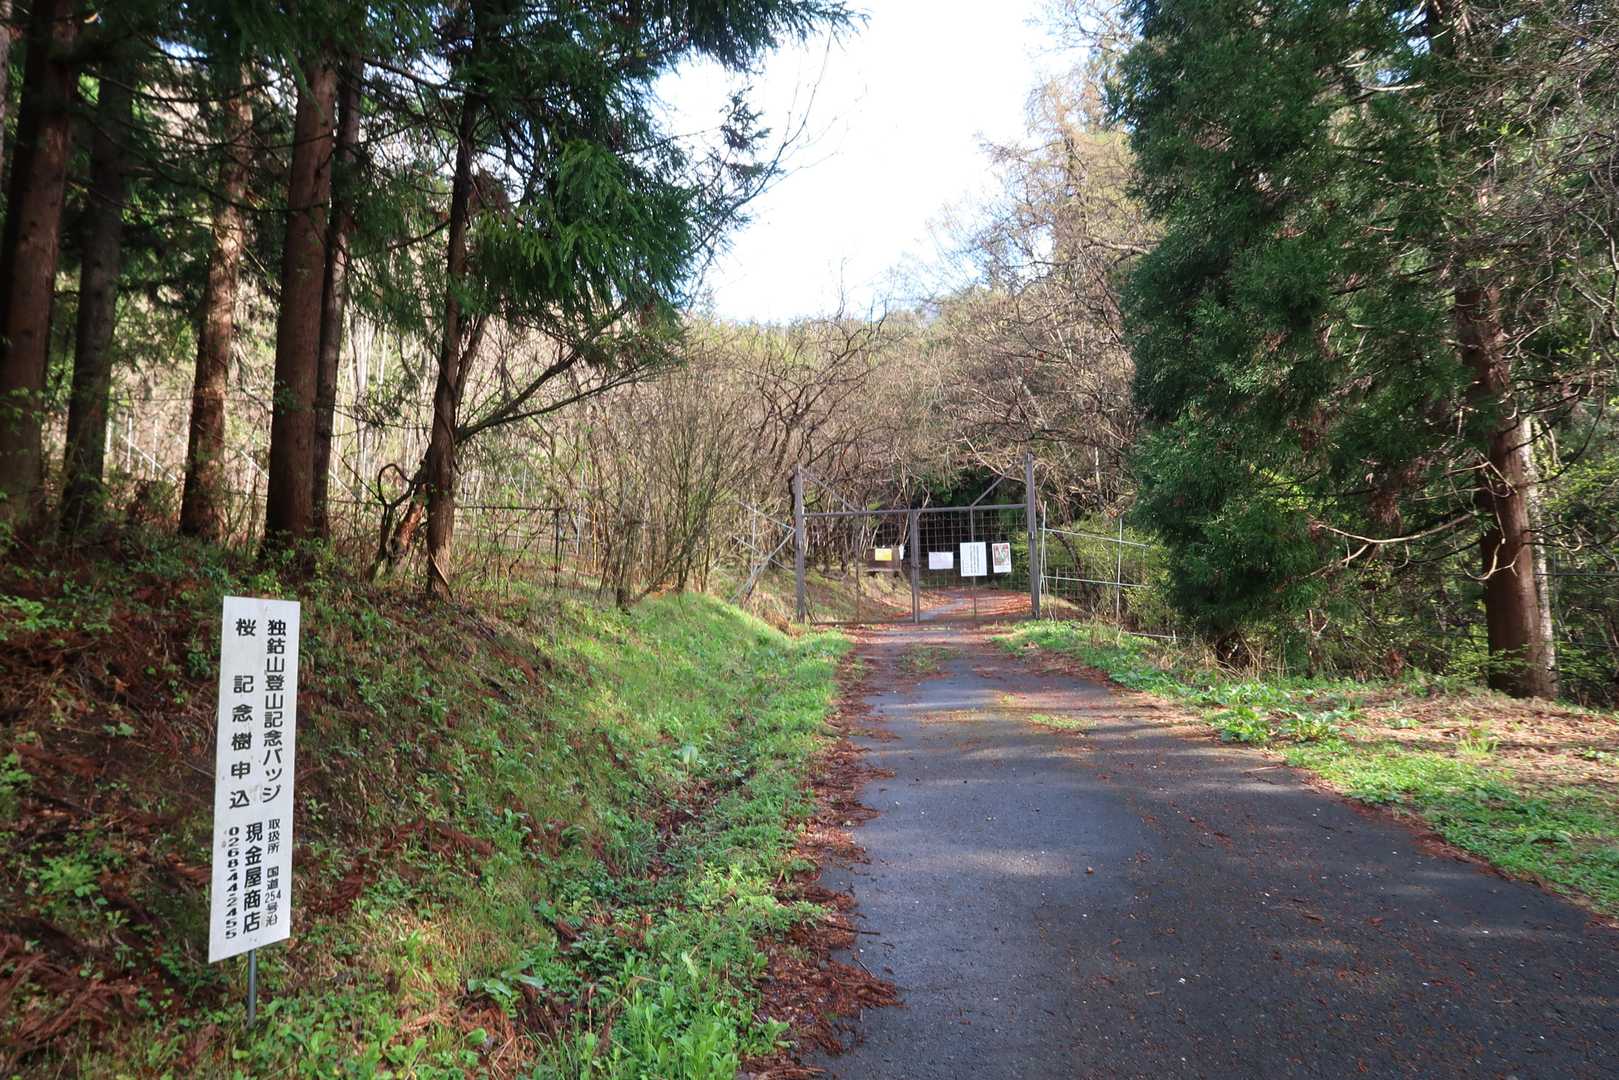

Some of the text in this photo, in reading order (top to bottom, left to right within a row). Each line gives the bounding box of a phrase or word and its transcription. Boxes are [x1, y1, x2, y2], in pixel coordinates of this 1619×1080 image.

[229, 618, 256, 809] 桜 記念樹申込
[243, 822, 263, 934] 現金屋商店
[267, 818, 281, 855] 取扱所
